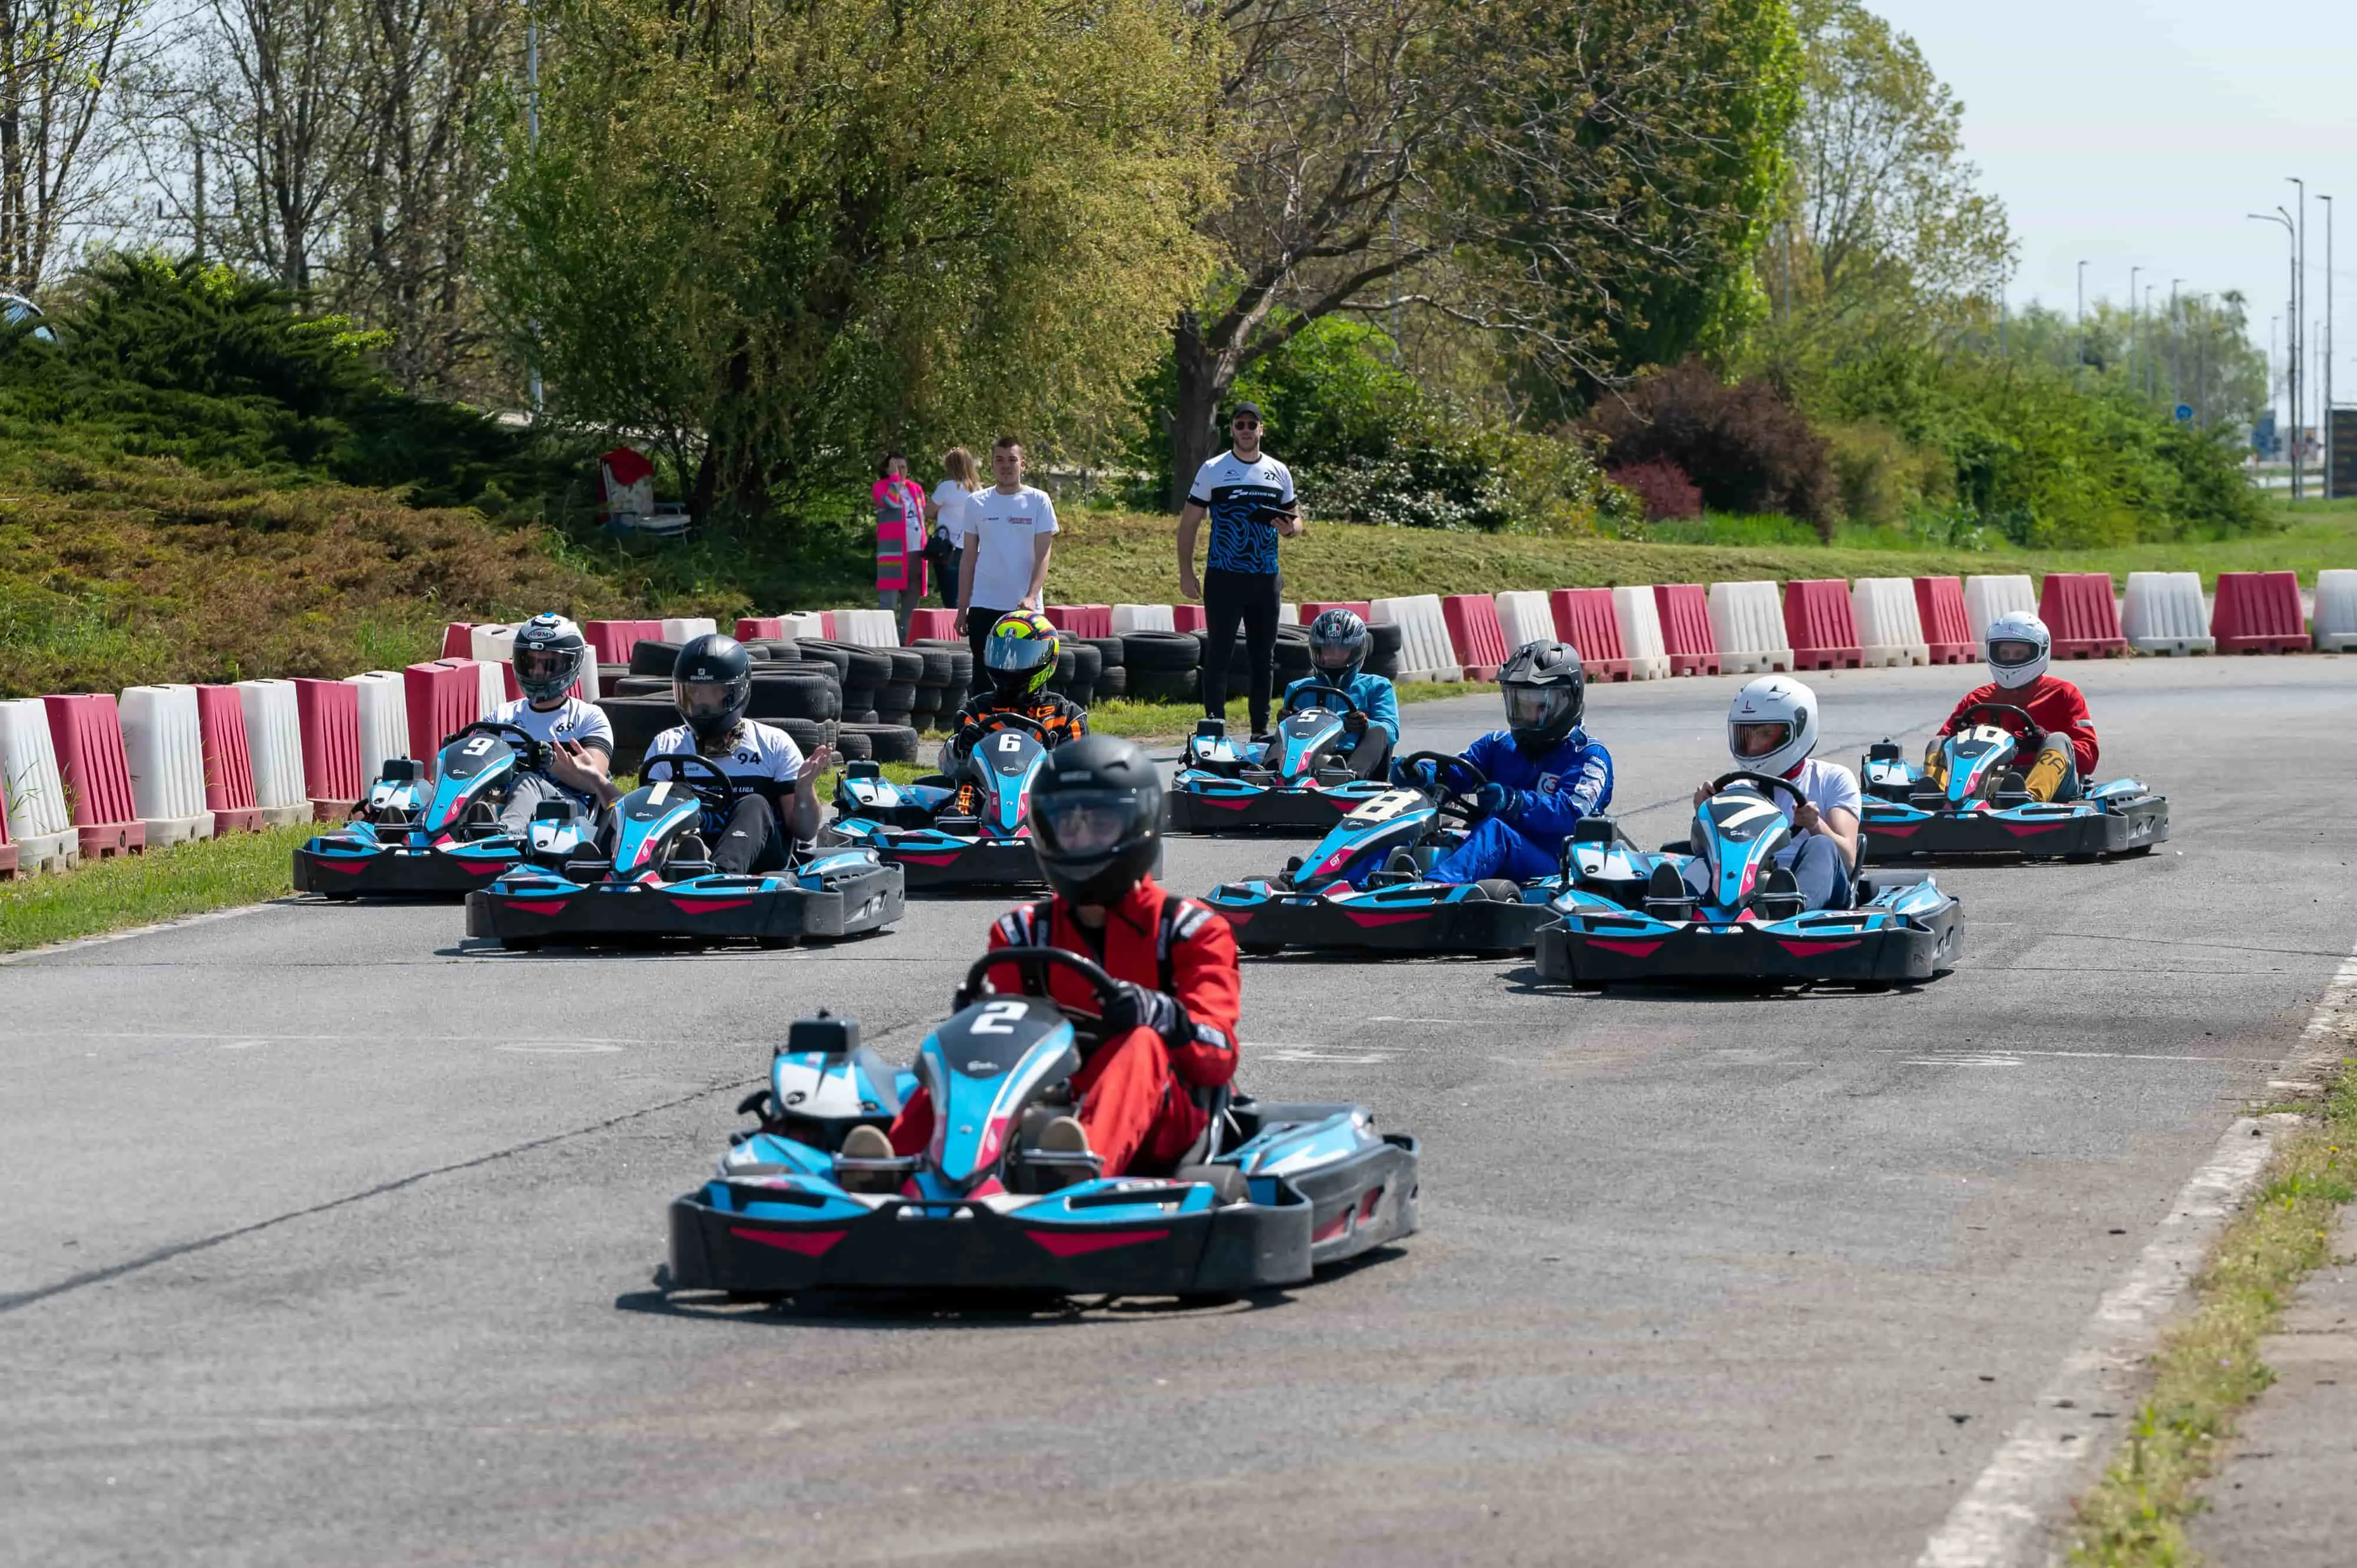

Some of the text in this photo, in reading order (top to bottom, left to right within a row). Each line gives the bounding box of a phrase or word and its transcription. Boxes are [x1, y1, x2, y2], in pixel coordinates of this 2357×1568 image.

[1264, 471, 1276, 481] 27
[1297, 709, 1322, 722] 5
[556, 722, 575, 732] 69
[1957, 724, 2013, 747] 10
[462, 737, 494, 756] 9
[998, 734, 1022, 752] 6
[737, 751, 761, 765] 94
[1343, 789, 1423, 822] 8
[1712, 795, 1782, 829] 7
[969, 1002, 1029, 1034] 2
